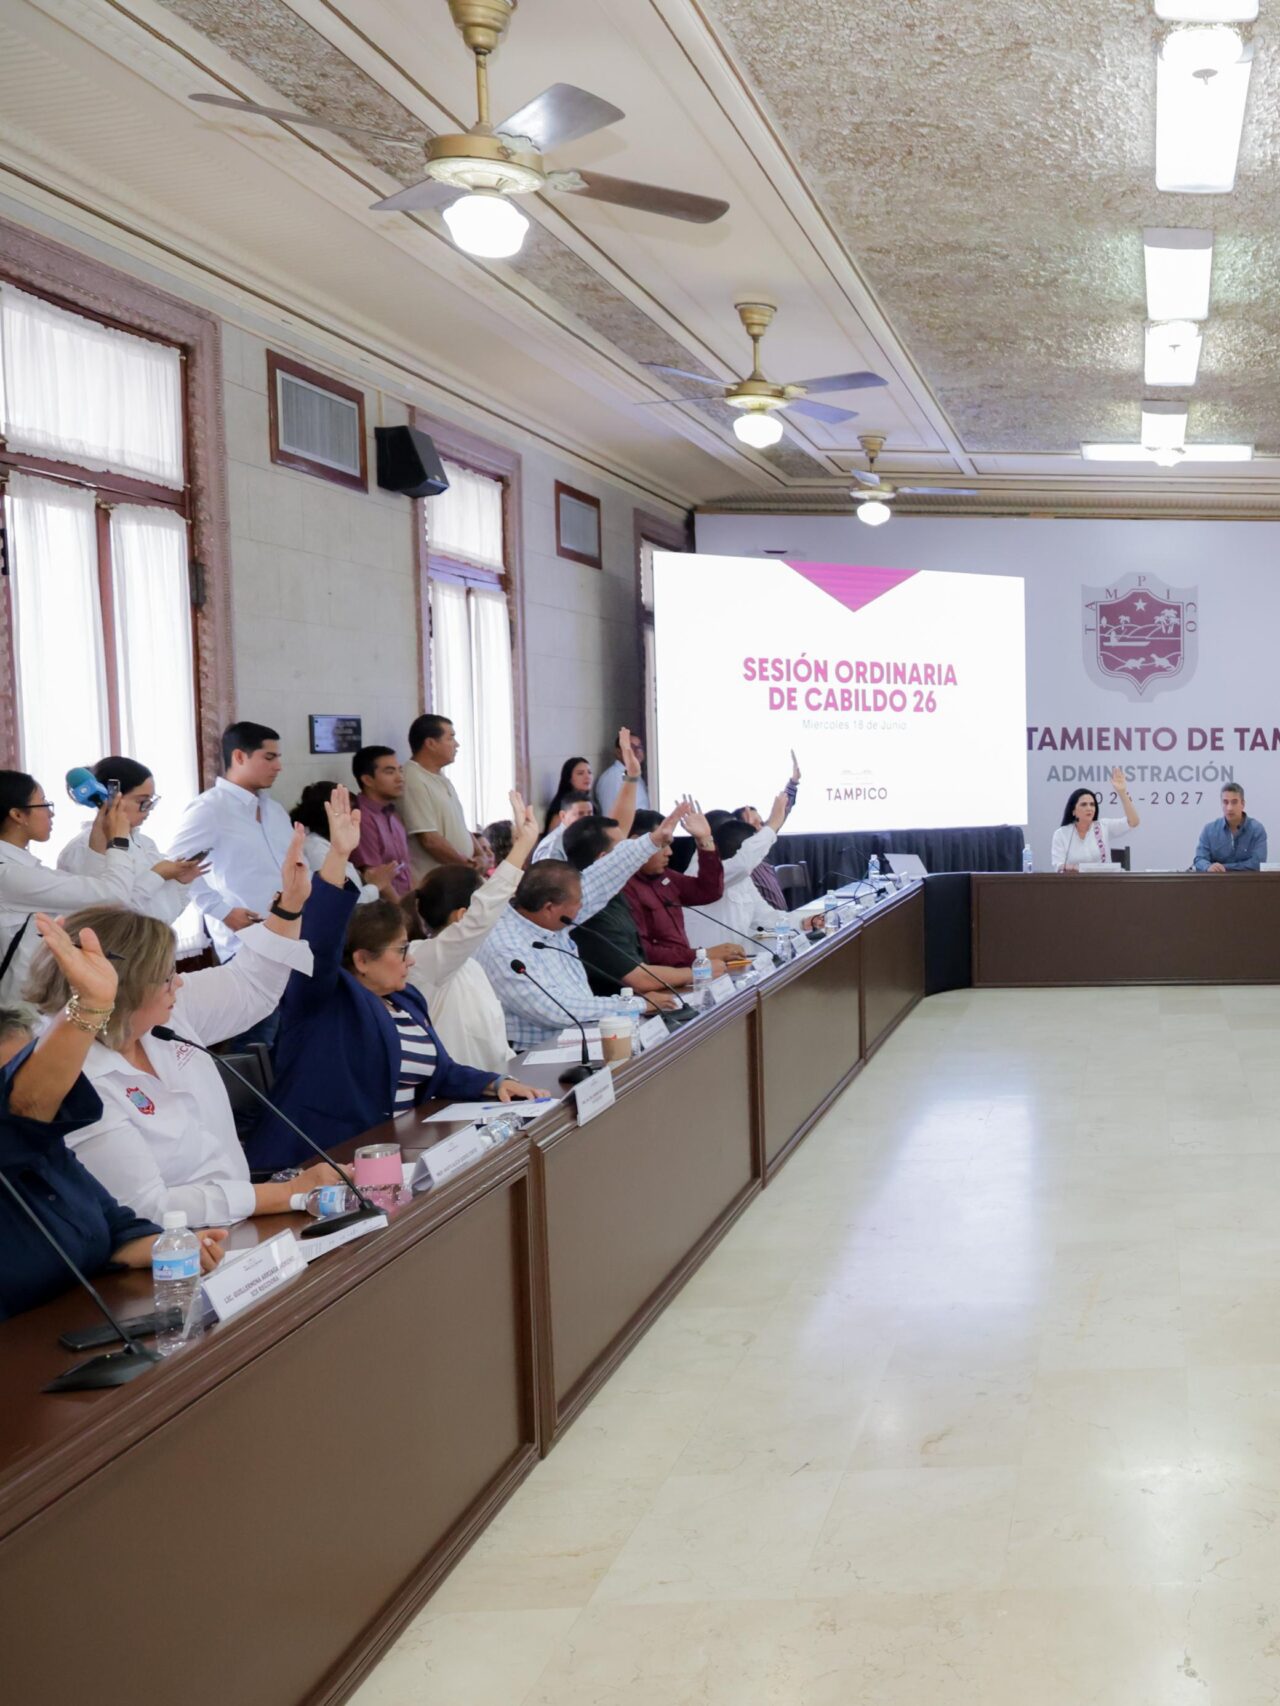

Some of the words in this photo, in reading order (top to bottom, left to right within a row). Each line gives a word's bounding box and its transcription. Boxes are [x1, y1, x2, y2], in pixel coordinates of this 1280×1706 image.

[743, 652, 829, 683] SESIÓN
[834, 659, 959, 686] ORDINARIA
[769, 687, 798, 711] DE
[804, 687, 907, 713] CABILDO
[912, 689, 938, 713] 26
[1026, 726, 1178, 752] TAMIENTO
[1187, 727, 1225, 751] DE
[826, 787, 888, 801] TAMPICO
